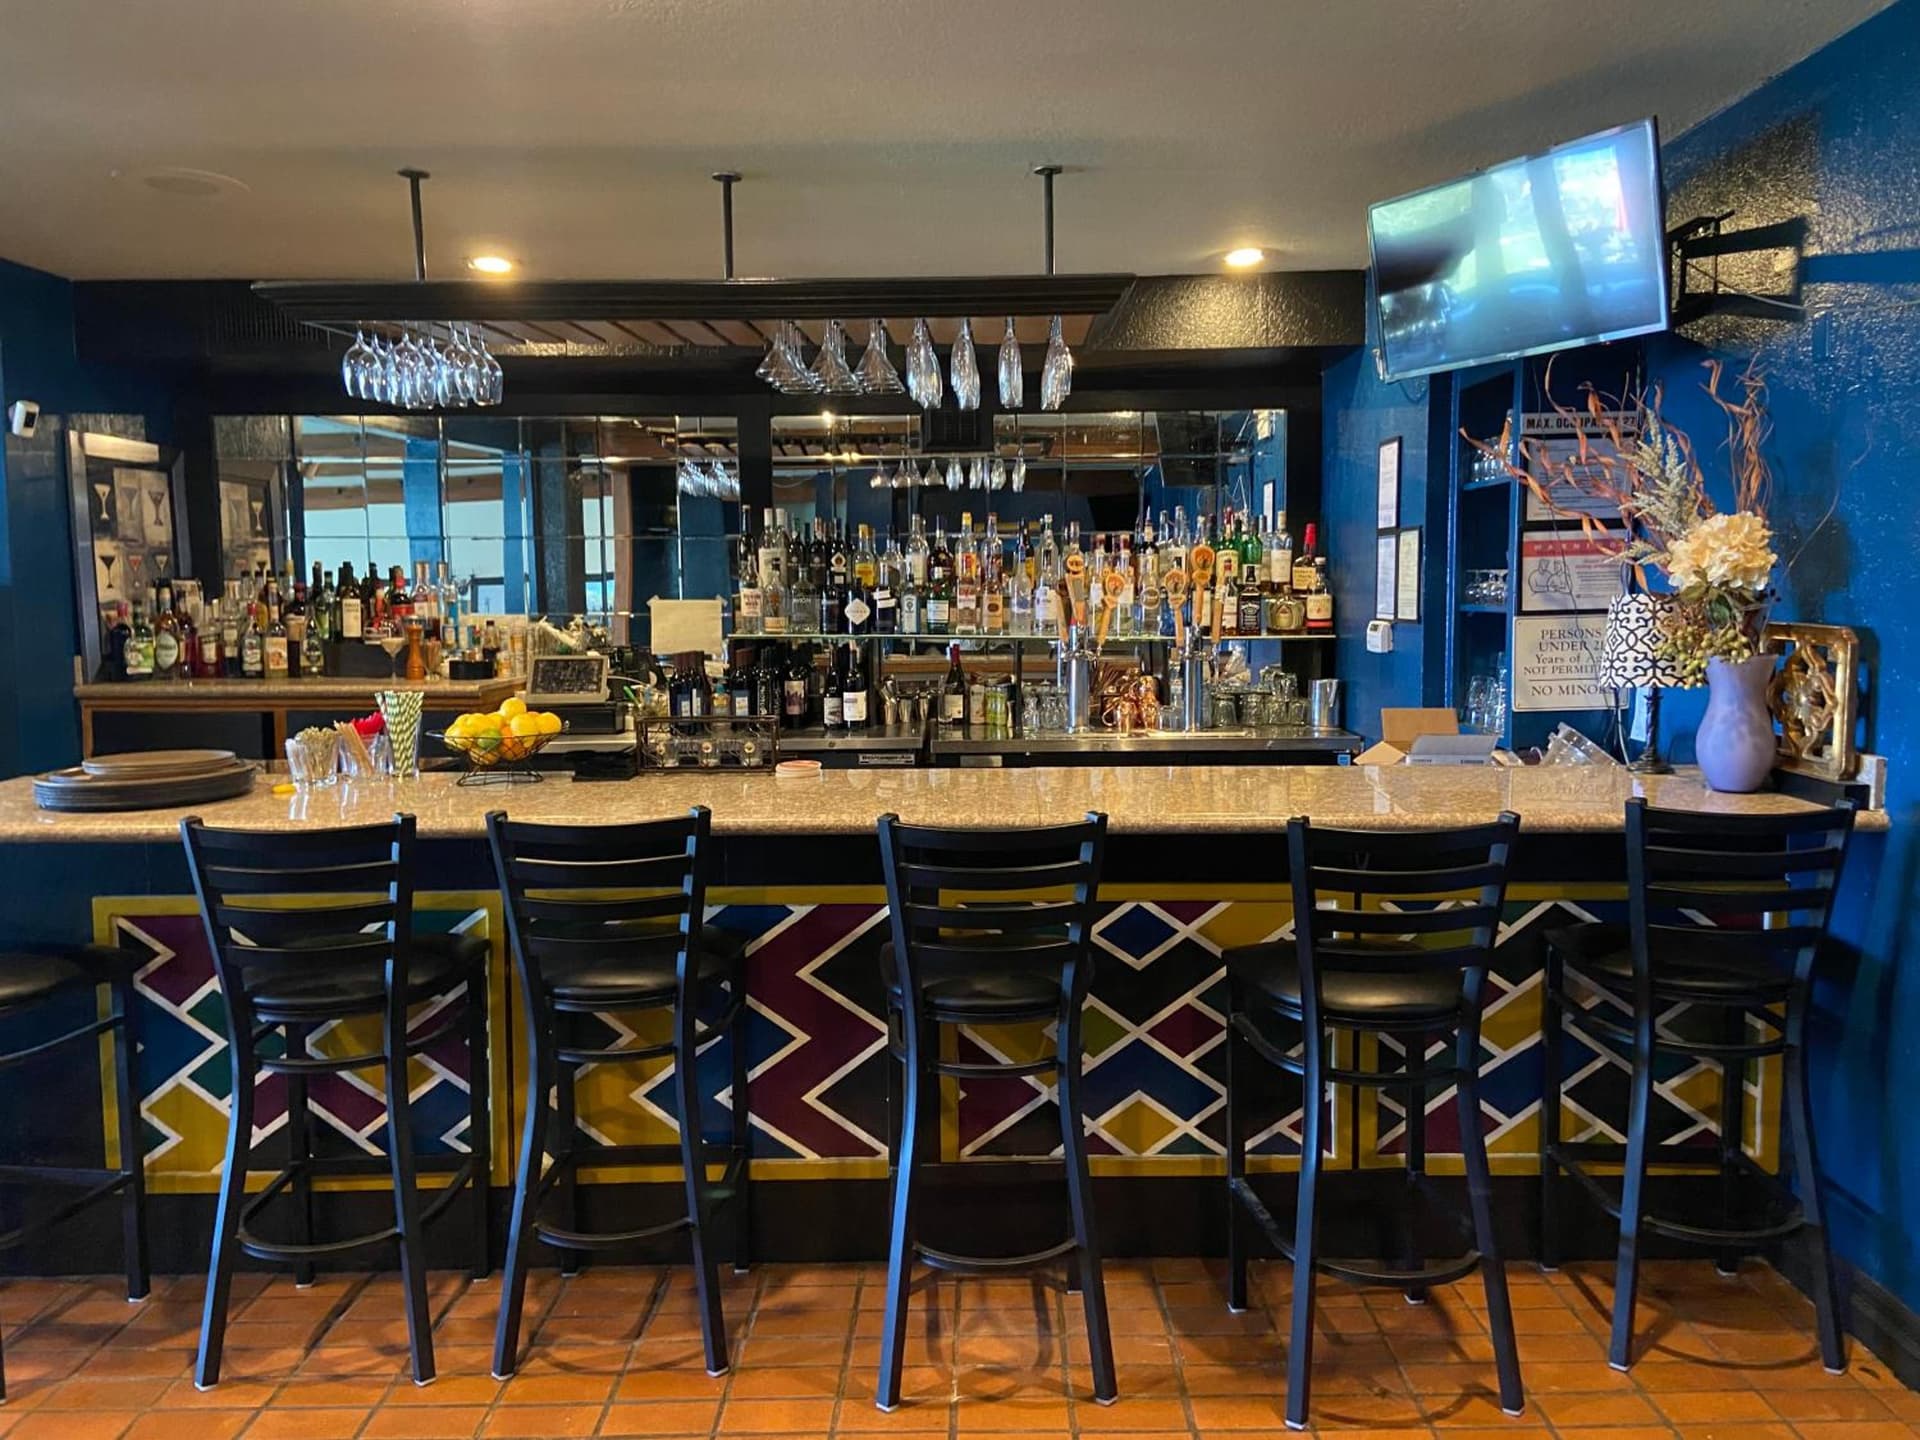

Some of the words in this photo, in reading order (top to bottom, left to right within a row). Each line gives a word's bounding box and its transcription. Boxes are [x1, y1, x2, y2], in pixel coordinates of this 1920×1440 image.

[1526, 417, 1553, 429] MAX.
[1541, 628, 1602, 640] PERSONS
[1539, 640, 1588, 652] UNDER
[1536, 653, 1565, 664] Years
[1569, 653, 1581, 664] of
[1524, 666, 1548, 675] NOT
[1531, 685, 1553, 696] NO
